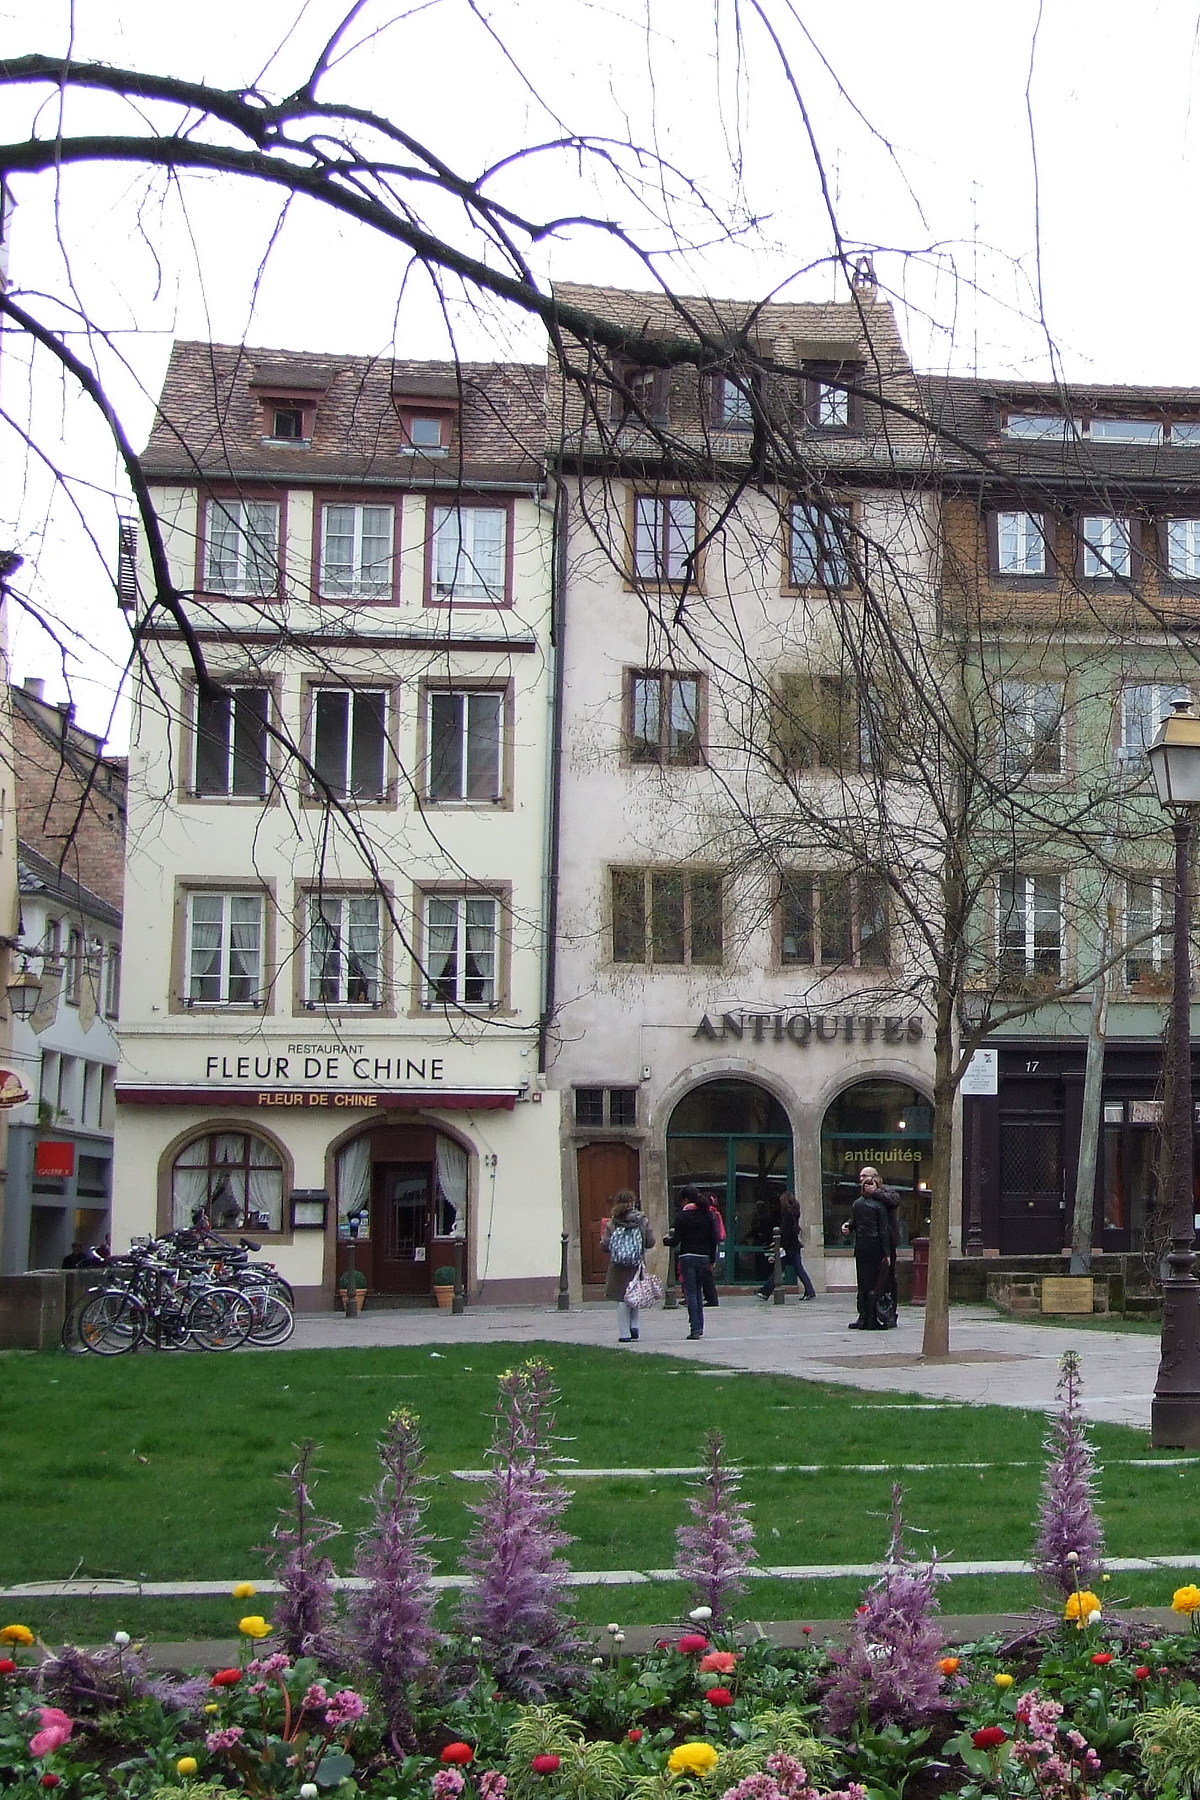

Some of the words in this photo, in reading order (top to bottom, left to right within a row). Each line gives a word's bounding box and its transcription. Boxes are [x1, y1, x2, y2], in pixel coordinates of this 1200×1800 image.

[692, 1013, 924, 1048] ANTIQUITES
[287, 1044, 364, 1055] RESTAURANT
[206, 1056, 290, 1079] FLEUR
[304, 1057, 338, 1079] DE
[353, 1058, 443, 1080] CHINE
[1025, 1061, 1040, 1072] 17
[258, 1093, 303, 1106] FLEUR
[309, 1094, 329, 1106] DE
[334, 1095, 377, 1107] CHINE
[844, 1149, 922, 1164] antiquités
